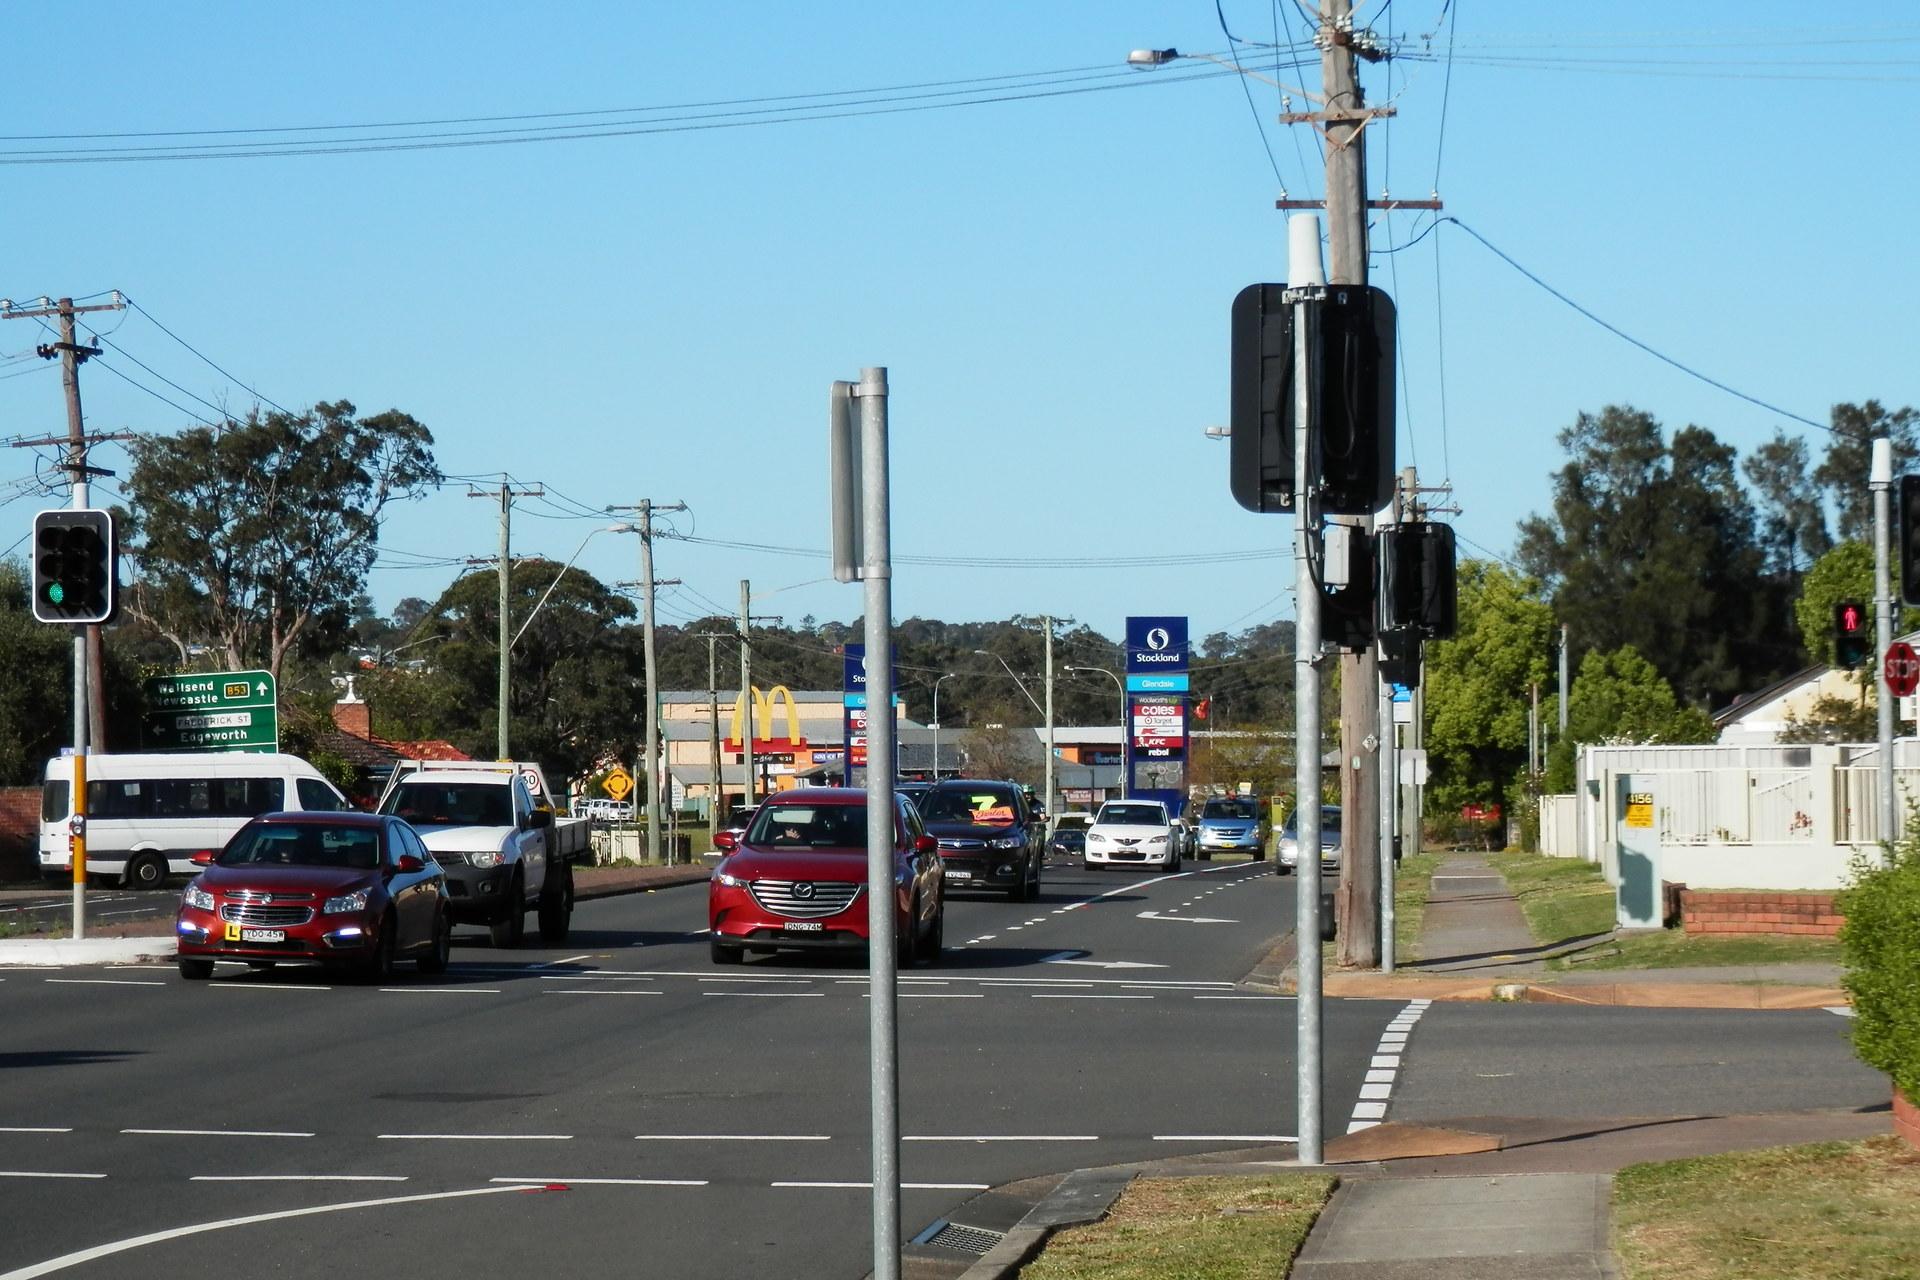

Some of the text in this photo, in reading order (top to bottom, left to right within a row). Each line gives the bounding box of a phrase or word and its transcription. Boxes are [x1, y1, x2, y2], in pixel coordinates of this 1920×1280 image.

[1136, 653, 1180, 662] Stockland
[1887, 659, 1917, 678] STOP
[158, 681, 214, 694] Wallsend
[1141, 680, 1175, 688] Glendale
[226, 685, 247, 696] B53
[1141, 705, 1175, 715] coles
[177, 715, 248, 727] FREDERICK ST
[181, 729, 248, 744] Edgeworth
[1148, 748, 1169, 756] rebel
[1628, 794, 1652, 803] 4156
[229, 925, 238, 938] L
